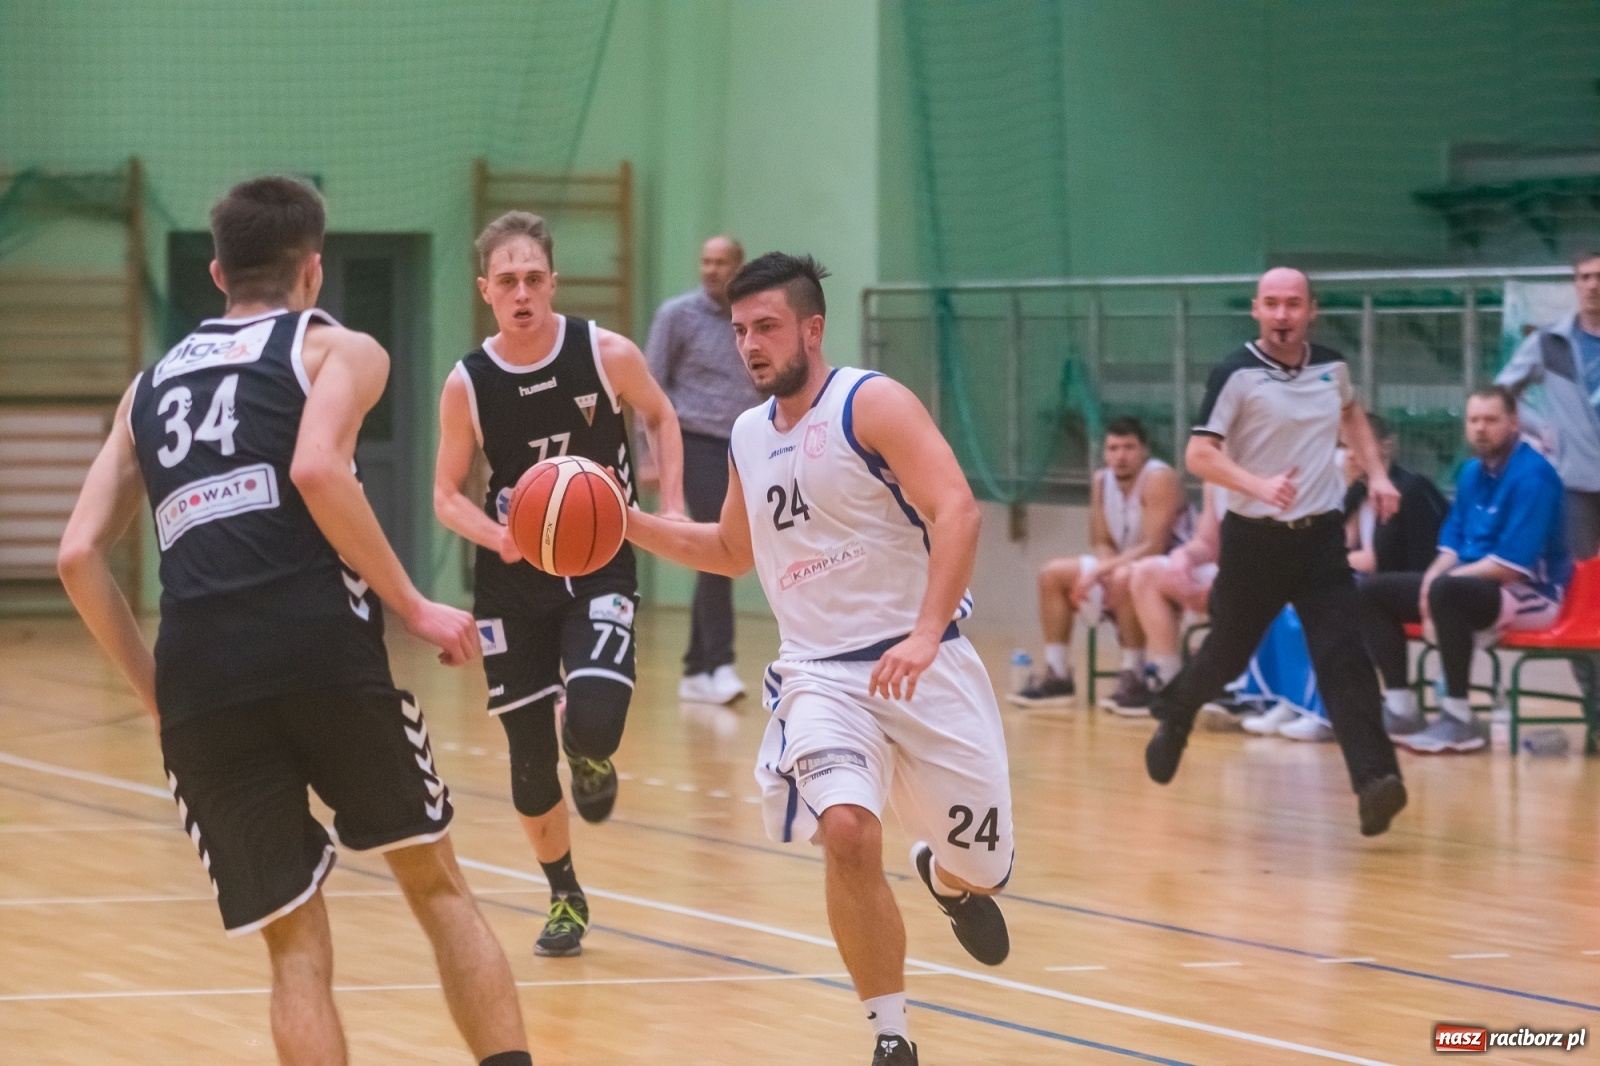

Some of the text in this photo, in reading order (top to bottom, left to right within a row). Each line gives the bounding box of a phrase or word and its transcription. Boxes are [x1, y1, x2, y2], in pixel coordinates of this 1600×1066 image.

[518, 376, 557, 397] hummel
[157, 373, 239, 468] 34
[766, 478, 811, 532] 24
[793, 551, 852, 580] KAMPKA
[590, 622, 631, 665] 77
[947, 804, 1000, 852] 24
